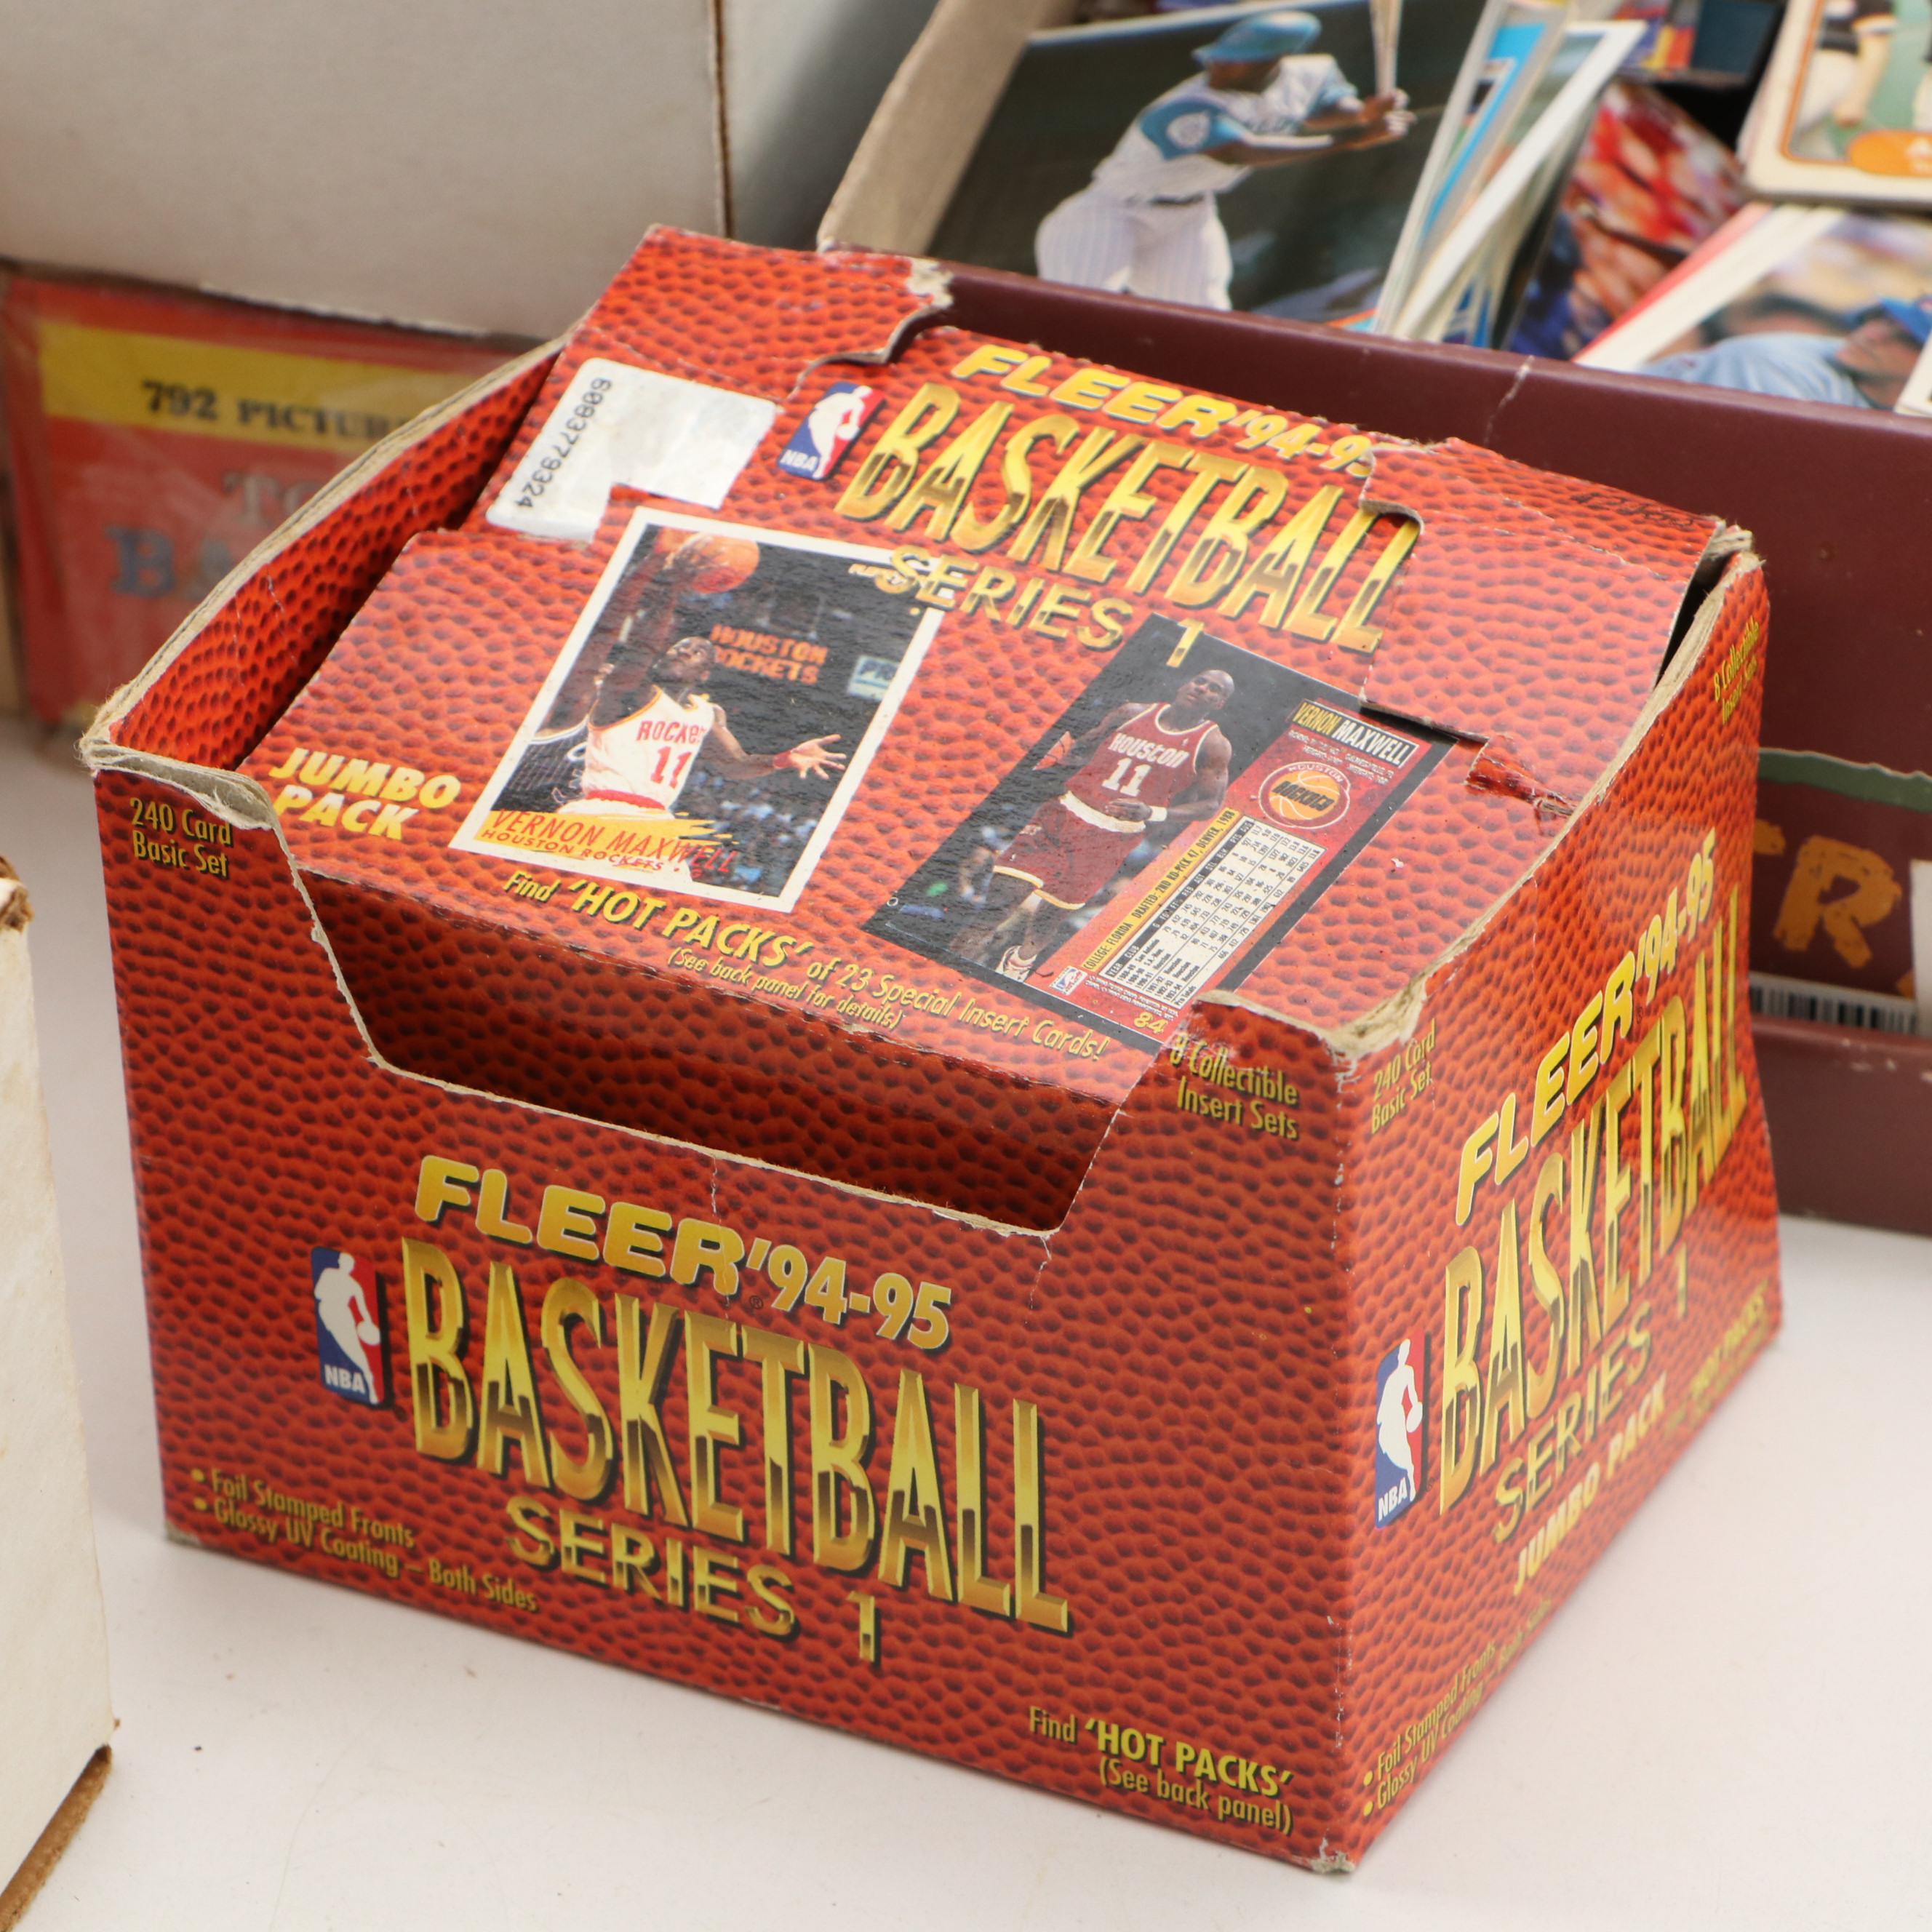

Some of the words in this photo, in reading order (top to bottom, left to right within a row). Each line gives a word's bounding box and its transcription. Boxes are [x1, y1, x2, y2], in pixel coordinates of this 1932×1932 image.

[142, 377, 217, 420] 792
[237, 397, 407, 440] PICTUR
[780, 449, 818, 471] NBA
[834, 382, 1421, 655] BASKETBALL
[875, 544, 1134, 651] SERIES
[709, 623, 829, 666] HOUSTON
[1165, 618, 1205, 668] 1
[1107, 732, 1191, 769] HOUSTON
[1292, 701, 1342, 736] VERNON
[1332, 719, 1410, 765] MAXWELL
[268, 746, 462, 809] JUMBO
[650, 746, 692, 790] 11
[1101, 757, 1152, 798] 11
[130, 797, 176, 833] 240
[181, 809, 233, 847] Card
[273, 784, 420, 840] PACK
[482, 829, 575, 854] HOUSTON
[493, 807, 604, 846] VERNON
[606, 830, 740, 873] MAXWELL
[132, 830, 188, 867] Basic
[193, 847, 230, 878] Set
[1083, 943, 1112, 971] COLLEGE:
[1106, 922, 1133, 946] FLORIDA
[1131, 892, 1162, 919] DRAFTED:
[503, 870, 562, 903] Find
[567, 878, 666, 930] 'HOT
[661, 906, 815, 968] PACKS'
[807, 954, 837, 982] of
[836, 963, 872, 993] 23
[872, 973, 962, 1018] Special
[958, 997, 1031, 1038] Insert
[1031, 1019, 1111, 1062] Cards!
[668, 946, 708, 973] (See
[709, 956, 754, 986] back
[752, 970, 807, 1000] panel
[807, 982, 837, 1008] for
[837, 993, 903, 1031] details)
[1133, 1011, 1169, 1034] 84
[1188, 1039, 1299, 1106] Collectible
[1373, 1063, 1400, 1102] 240
[1405, 1018, 1437, 1070] Card
[1176, 1076, 1244, 1126] Insert
[1250, 1101, 1299, 1141] Sets
[1370, 1087, 1407, 1135] Basic
[1410, 1062, 1432, 1101] Set
[1440, 882, 1747, 1516] BASKETBALL
[324, 1364, 367, 1394] NBA
[401, 1236, 1069, 1634] BASKETBALL
[1492, 1301, 1651, 1544] SERIES
[212, 1468, 249, 1502] Foil
[254, 1479, 344, 1528] Stamped
[351, 1506, 416, 1549] Fronts
[1378, 1476, 1408, 1522] NBA
[1514, 1461, 1600, 1596] JUMBO
[1606, 1371, 1668, 1481] PACK
[213, 1498, 279, 1543] Glossy
[284, 1517, 315, 1547] UV
[321, 1529, 400, 1578] Coating
[428, 1558, 477, 1594] Both
[481, 1573, 539, 1613] Sides
[505, 1496, 799, 1638] SERIES
[845, 1590, 877, 1664] 1
[1029, 1705, 1077, 1744] Find
[1085, 1717, 1165, 1766] 'HOT
[1175, 1741, 1295, 1797] PACKS'
[1377, 1755, 1418, 1810] Glossy
[1421, 1721, 1440, 1763] UV
[1378, 1733, 1402, 1781] Foil
[1099, 1757, 1149, 1793] (See
[1156, 1768, 1212, 1811] back
[1218, 1795, 1293, 1835] panel)
